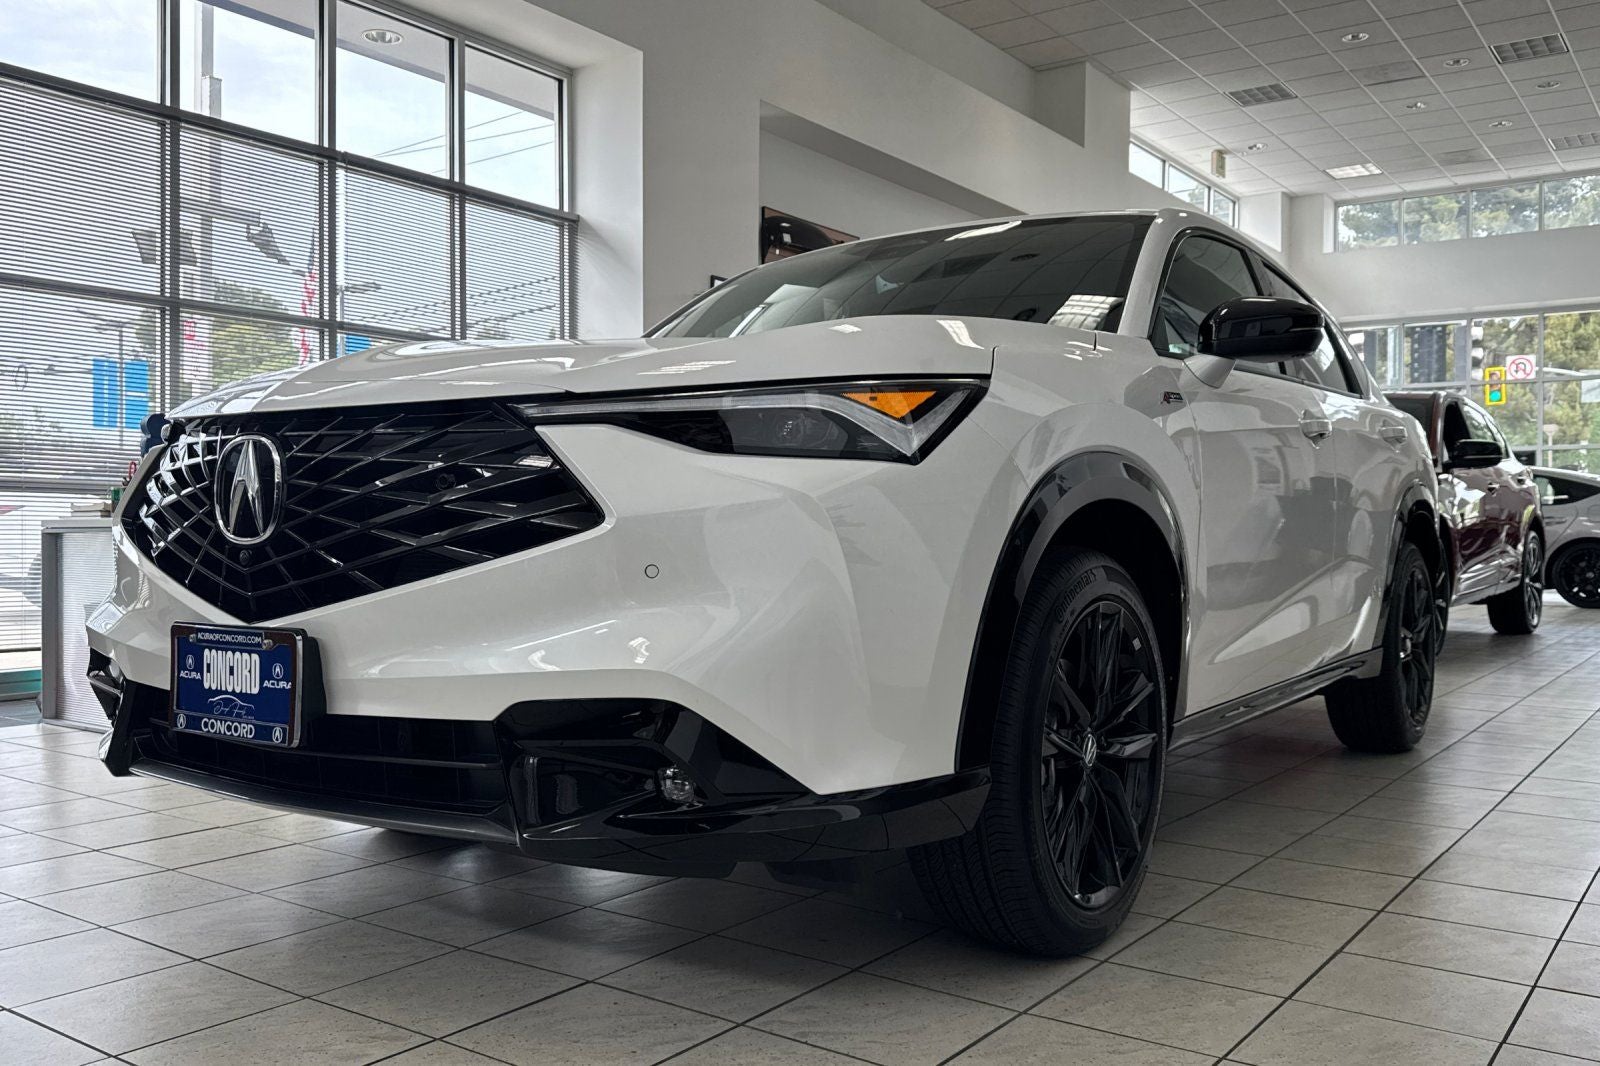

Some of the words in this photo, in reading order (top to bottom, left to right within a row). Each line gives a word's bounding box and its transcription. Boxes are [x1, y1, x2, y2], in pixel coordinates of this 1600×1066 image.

[197, 632, 262, 644] ACURAOFCONCORD.COM
[180, 670, 202, 680] ACURA
[203, 648, 260, 695] CONCORD
[201, 718, 255, 739] CONCORD
